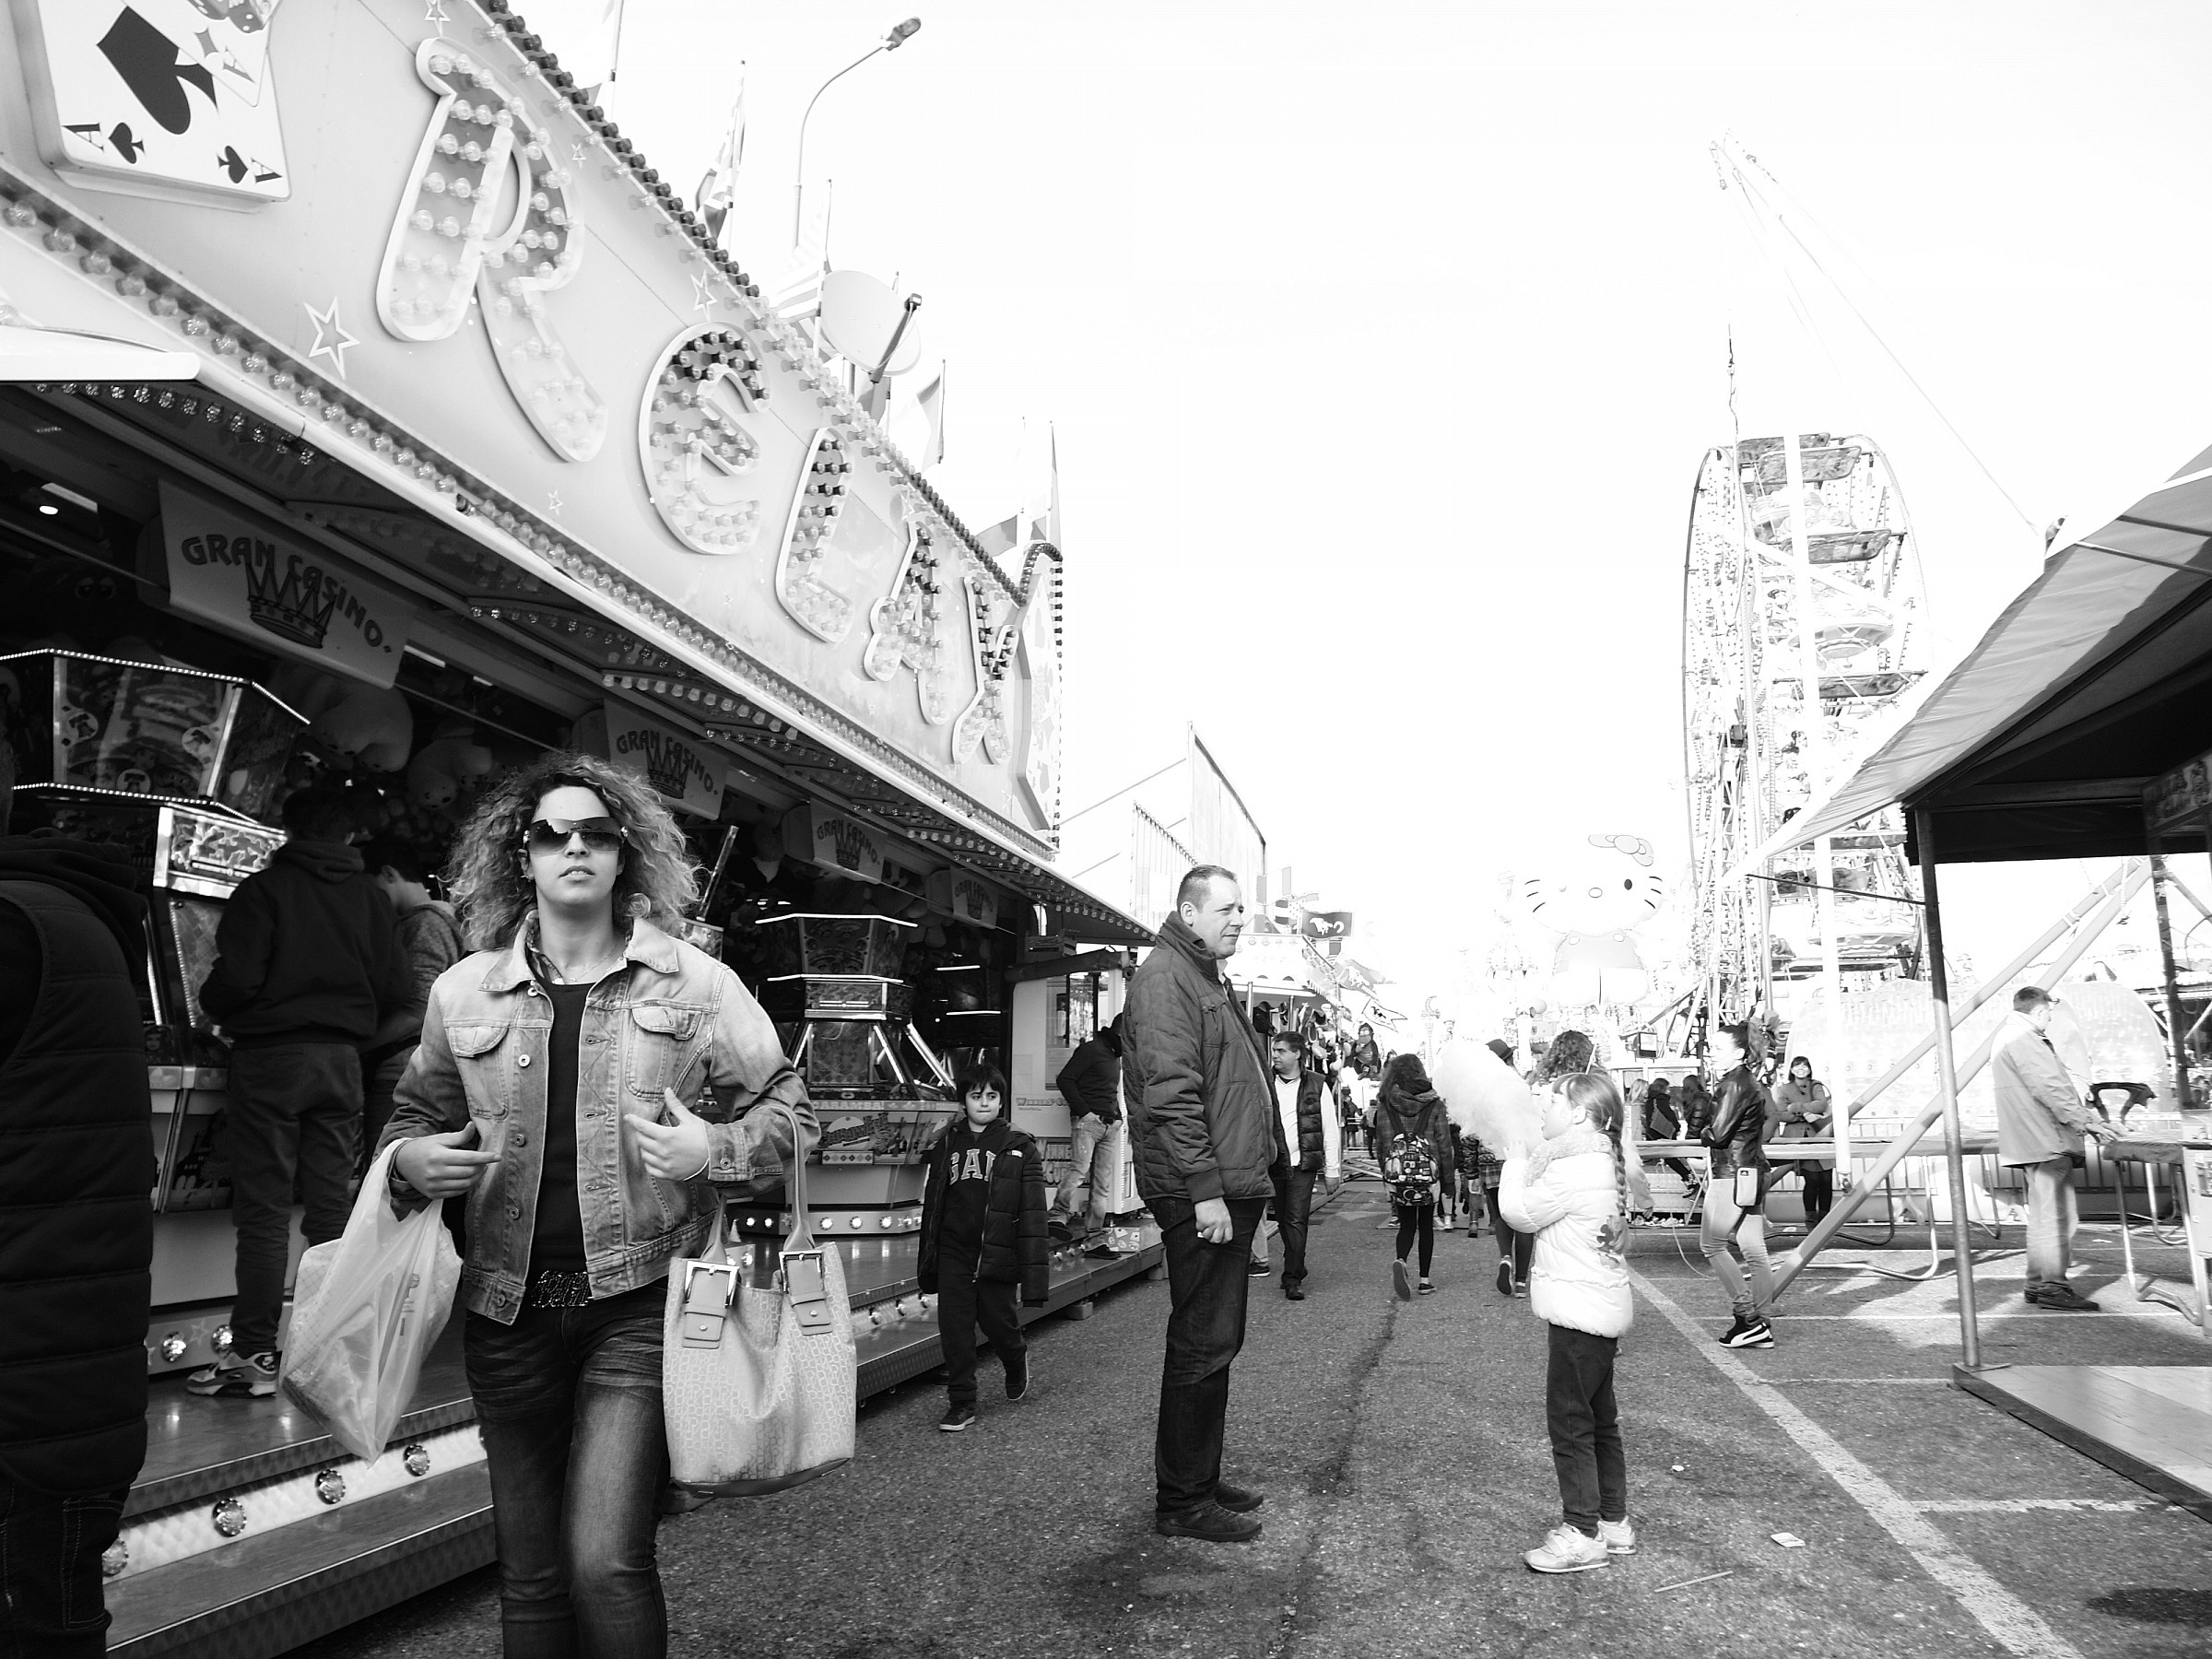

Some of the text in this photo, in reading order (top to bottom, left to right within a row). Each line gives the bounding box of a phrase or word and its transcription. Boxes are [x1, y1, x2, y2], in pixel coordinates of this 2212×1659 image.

[62, 123, 105, 152] A
[251, 157, 283, 183] A
[181, 534, 276, 567] GRAN
[617, 730, 660, 754] GRAN
[818, 819, 844, 841] GRAN
